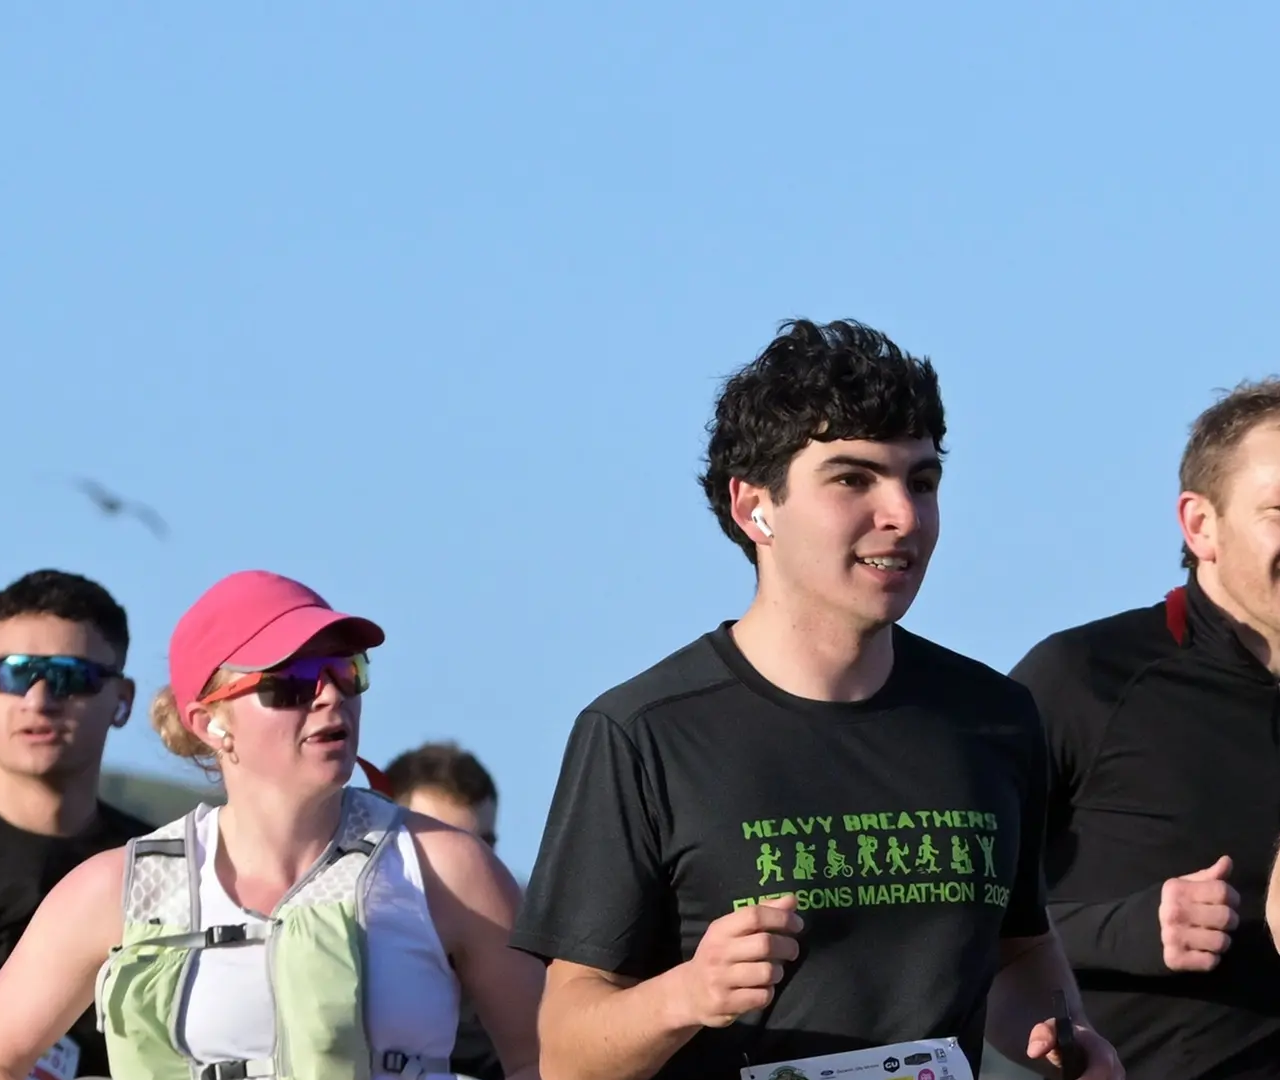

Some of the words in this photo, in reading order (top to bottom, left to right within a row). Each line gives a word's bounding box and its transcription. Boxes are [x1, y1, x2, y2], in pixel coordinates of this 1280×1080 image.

[742, 816, 832, 840] HEAVY
[843, 810, 998, 832] BREATHERS
[858, 881, 975, 906] MARATHON
